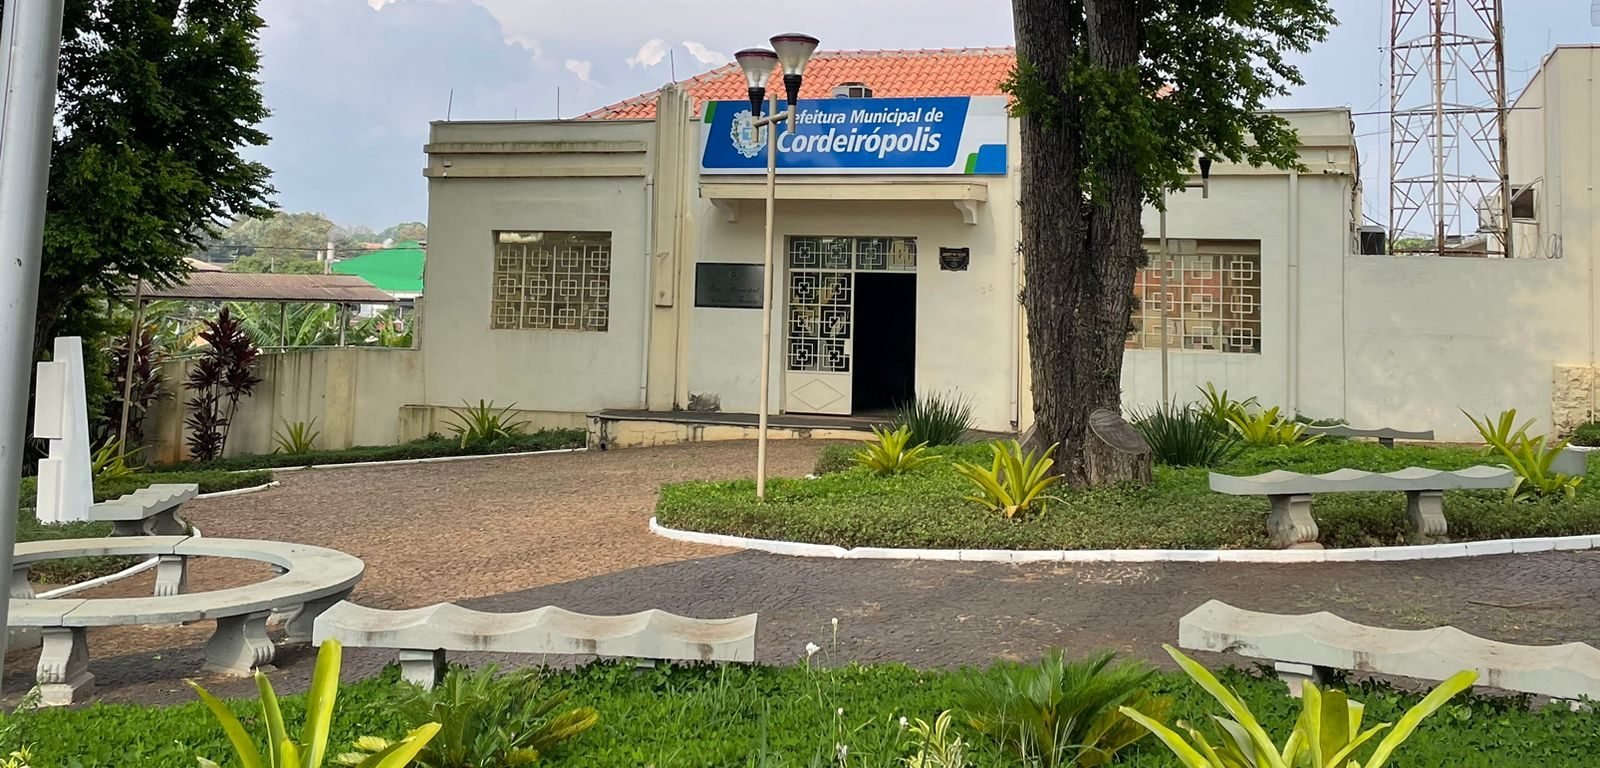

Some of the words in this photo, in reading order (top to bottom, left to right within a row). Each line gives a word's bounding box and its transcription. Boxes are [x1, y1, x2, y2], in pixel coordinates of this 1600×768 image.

[776, 109, 847, 125] efeitura
[849, 107, 923, 127] Municipal
[924, 106, 944, 123] de
[776, 126, 942, 159] Cordeirópolis
